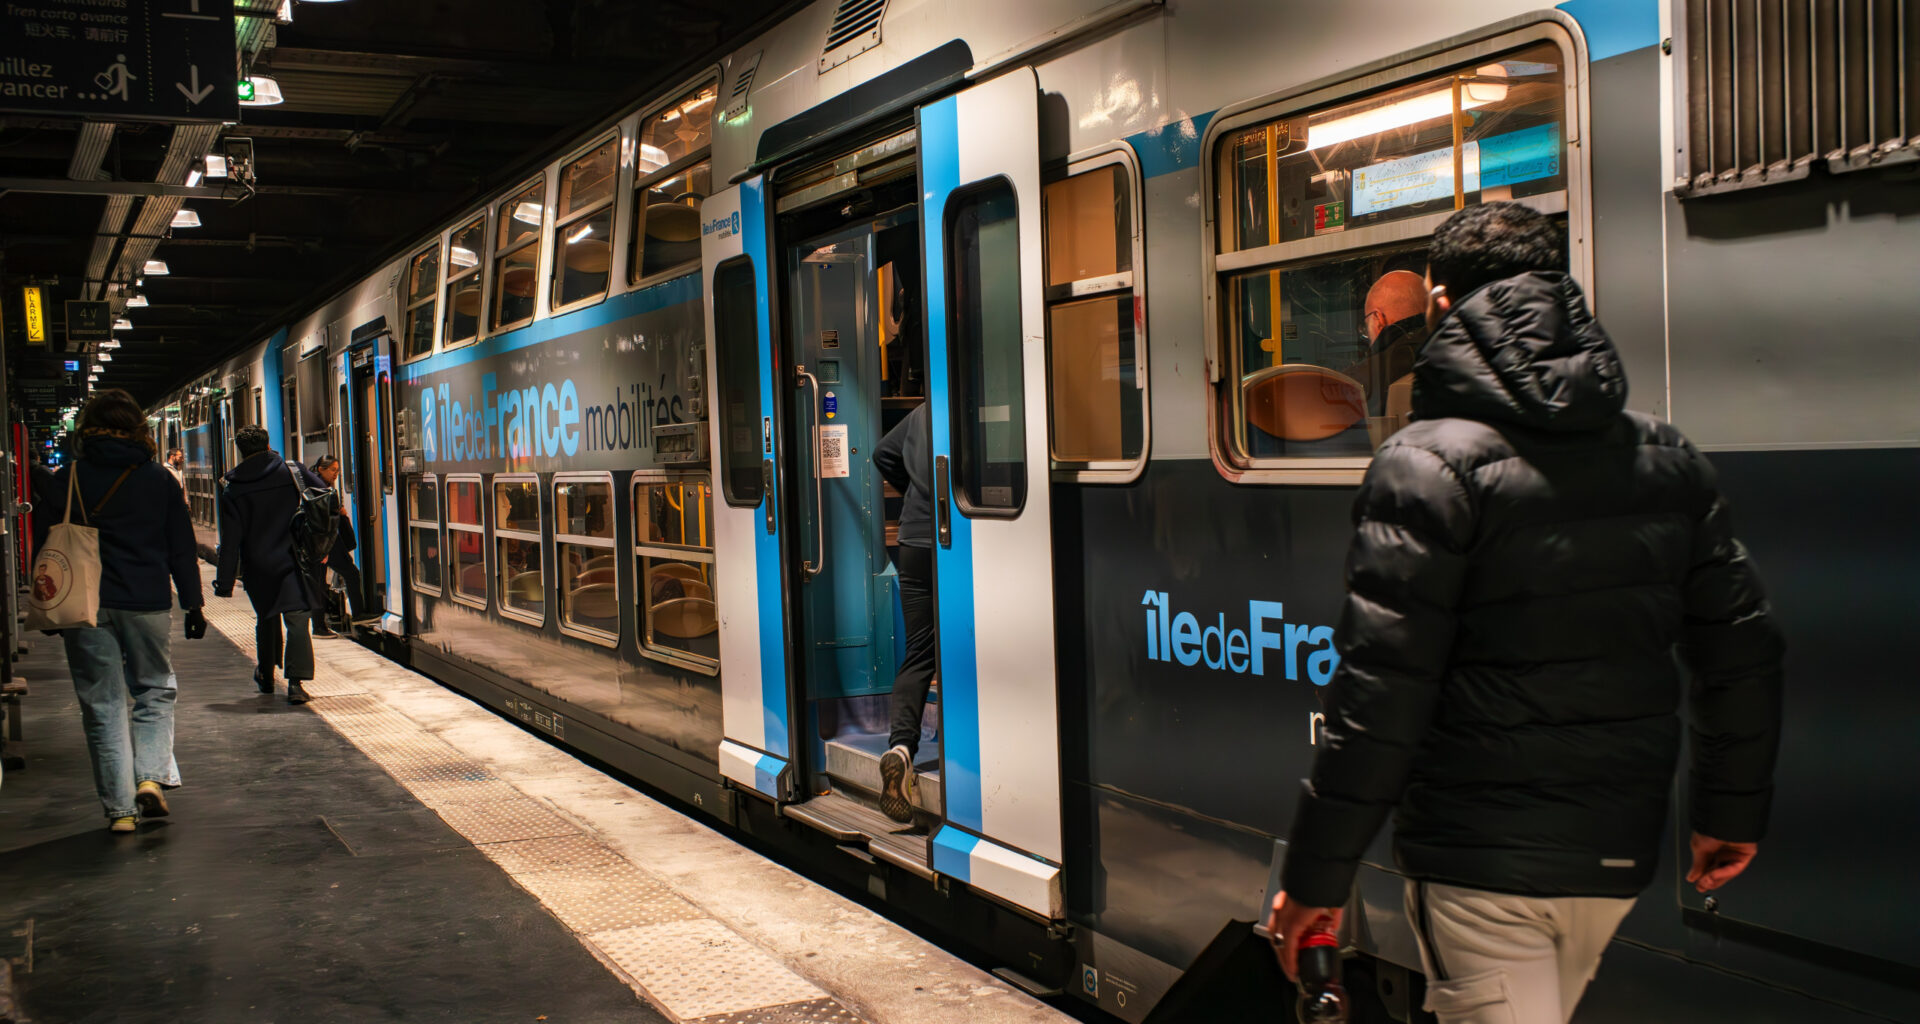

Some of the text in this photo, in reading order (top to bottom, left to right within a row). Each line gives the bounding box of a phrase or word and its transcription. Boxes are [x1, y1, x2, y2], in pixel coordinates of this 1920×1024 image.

[7, 3, 128, 25] Tren corto avance
[28, 289, 38, 329] ALARME
[585, 374, 683, 452] mobilités
